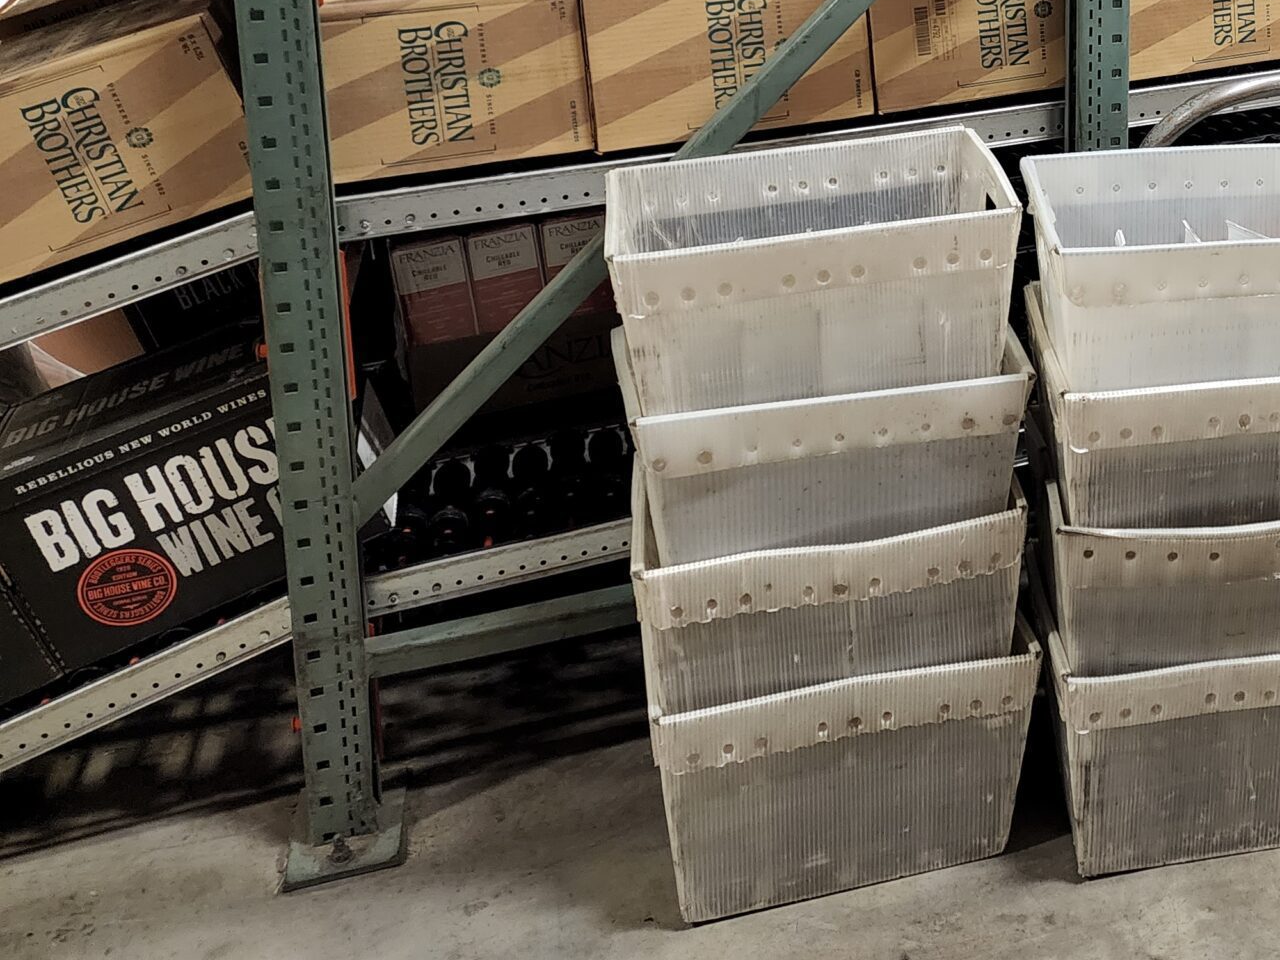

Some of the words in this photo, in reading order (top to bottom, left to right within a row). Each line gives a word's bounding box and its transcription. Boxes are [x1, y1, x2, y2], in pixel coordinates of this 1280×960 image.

[397, 25, 440, 146] BROTHERS
[434, 20, 475, 142] CHRISTIAN
[19, 98, 106, 224] BROTHERS
[60, 86, 145, 213] CHRISTIAN
[398, 243, 457, 264] FRANZIA
[411, 263, 448, 278] CHILLABLE
[473, 228, 528, 252] FRANZIA
[485, 249, 521, 263] CHILLABLE
[548, 218, 600, 239] FRANZIA
[175, 268, 241, 311] BLACK
[62, 372, 167, 428] HOUSE
[173, 343, 247, 382] WINE
[14, 449, 114, 495] REBELLIOUS
[118, 434, 154, 456] NEW
[157, 411, 213, 440] WORLD
[216, 388, 267, 414] WINES
[24, 486, 136, 573] BIG
[123, 417, 279, 532] HOUS
[155, 495, 276, 579] WINE
[87, 587, 103, 601] BIG
[104, 583, 131, 597] HOUSE
[132, 578, 153, 591] WINE
